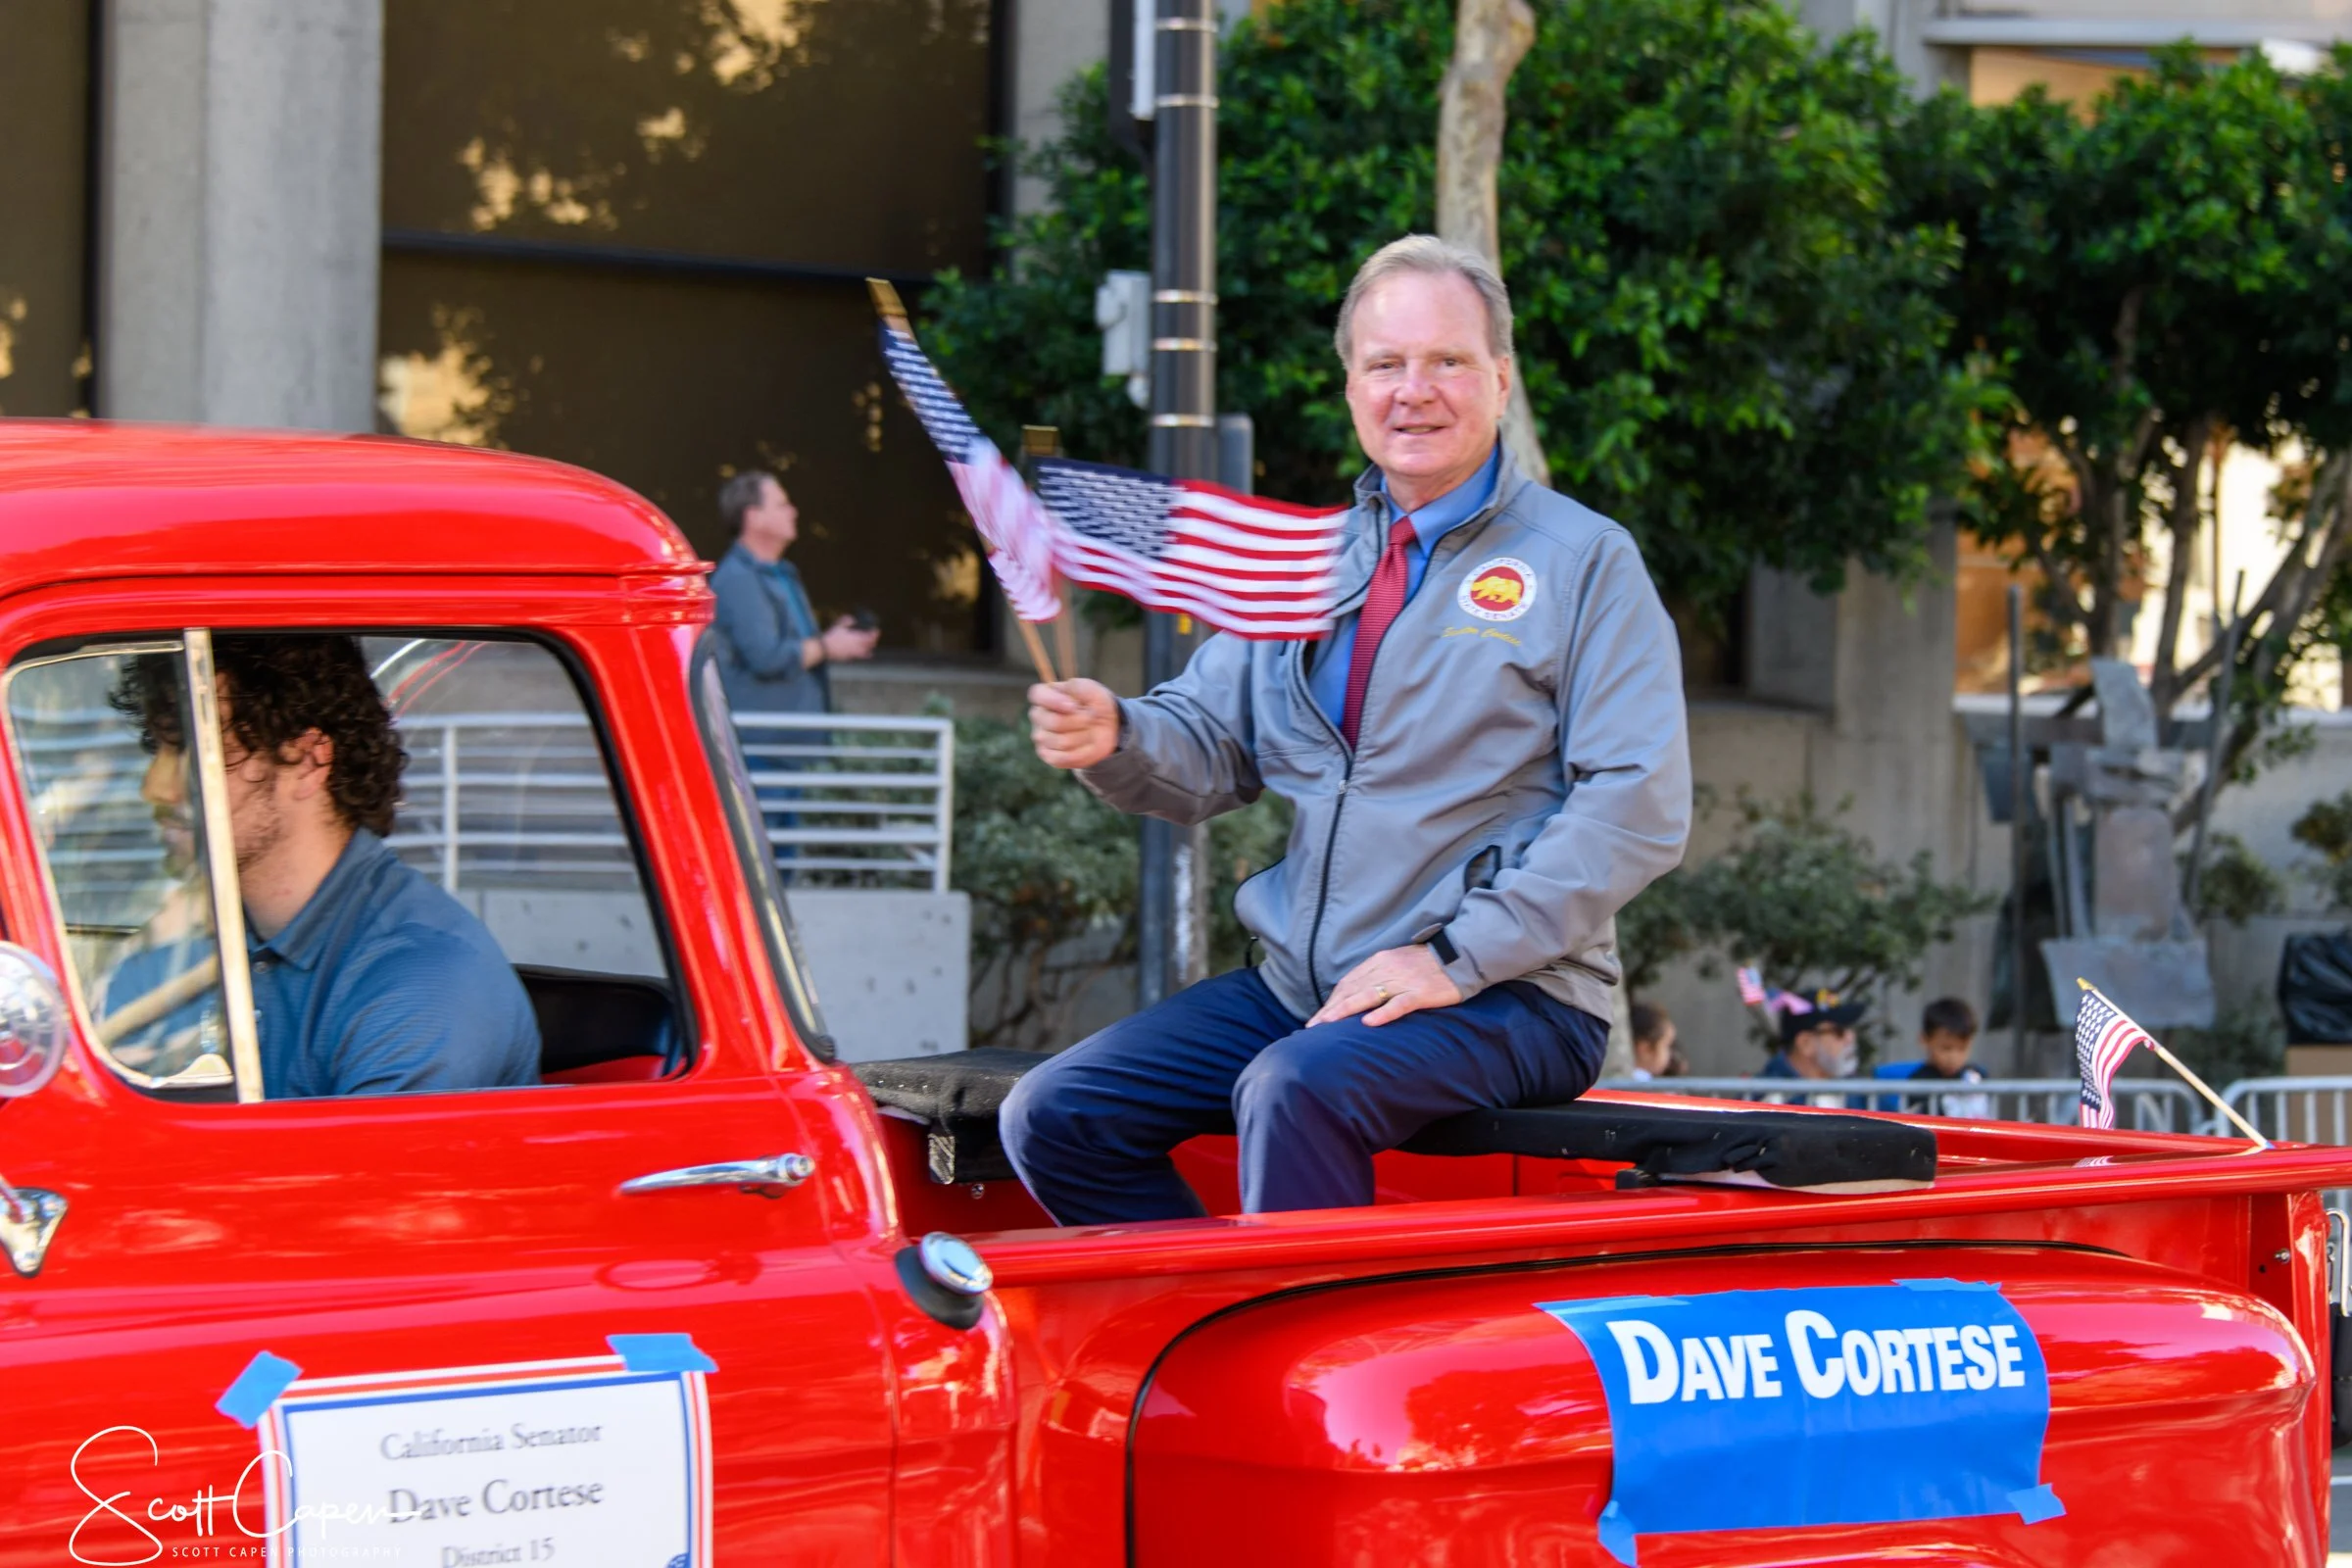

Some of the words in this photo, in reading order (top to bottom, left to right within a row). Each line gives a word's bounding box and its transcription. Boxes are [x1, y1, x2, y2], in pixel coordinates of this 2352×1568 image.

[1605, 1319, 1783, 1404] DAVE
[1785, 1309, 2026, 1398] CORTESE
[379, 1427, 506, 1460] California
[510, 1422, 604, 1449] Senator
[388, 1487, 472, 1524] Dave
[481, 1478, 606, 1515] Cortese
[440, 1542, 522, 1568] District
[530, 1537, 557, 1563] 15
